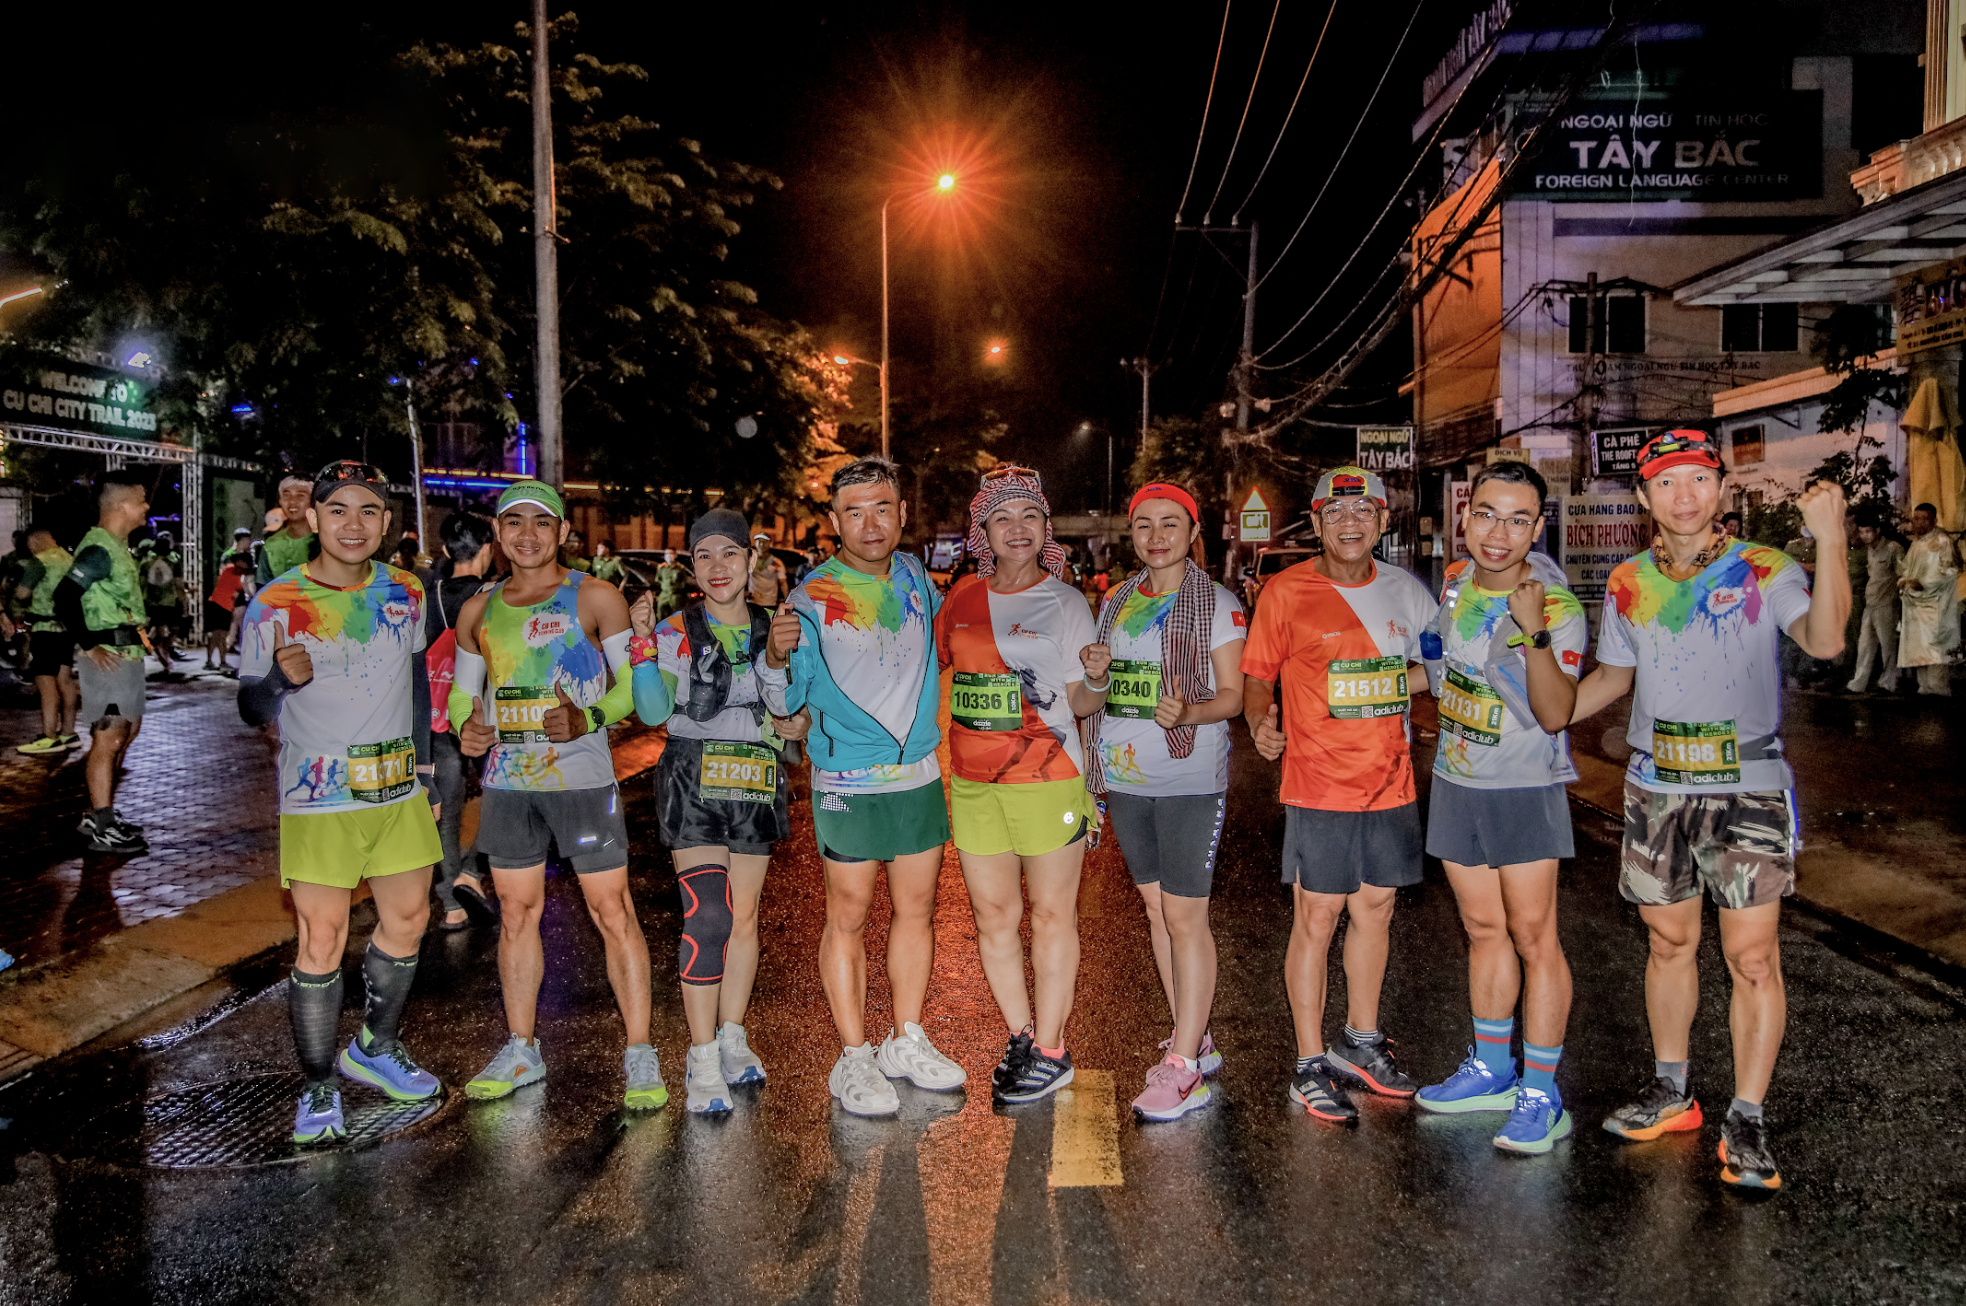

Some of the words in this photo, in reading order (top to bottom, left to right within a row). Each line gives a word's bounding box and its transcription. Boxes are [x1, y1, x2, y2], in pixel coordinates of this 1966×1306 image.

[1569, 134, 1661, 169] TÂY
[1674, 129, 1761, 168] BẮC
[1536, 174, 1613, 189] FOREIGN
[1619, 174, 1715, 188] LANGUAGE
[1722, 174, 1790, 186] CENTER
[2, 389, 25, 411] CU
[27, 393, 53, 416] CHI
[55, 397, 86, 420] CITY
[87, 402, 126, 427] TRAIL
[126, 409, 157, 432] 2023
[1360, 431, 1388, 446] NGOẠI
[1603, 434, 1618, 449] CÀ
[1620, 433, 1641, 448] PHÊ
[1360, 448, 1384, 469] TÂY
[1385, 445, 1409, 469] BẮC
[1600, 450, 1614, 462] THE
[1616, 503, 1635, 515] BAO
[1566, 518, 1594, 547] BÍCH
[1597, 519, 1647, 547] PHƯƠNG
[1592, 553, 1610, 564] CUNG
[1109, 679, 1151, 698] 0340
[1334, 677, 1392, 698] 21512
[954, 691, 1002, 710] 10336
[1374, 704, 1404, 716] adiclub
[1442, 689, 1481, 721] 21131
[1491, 707, 1499, 726] 21Km
[1462, 730, 1494, 744] adiclub
[1657, 740, 1715, 762] 21198
[707, 762, 761, 781] 21203
[1693, 772, 1734, 783] adiclub
